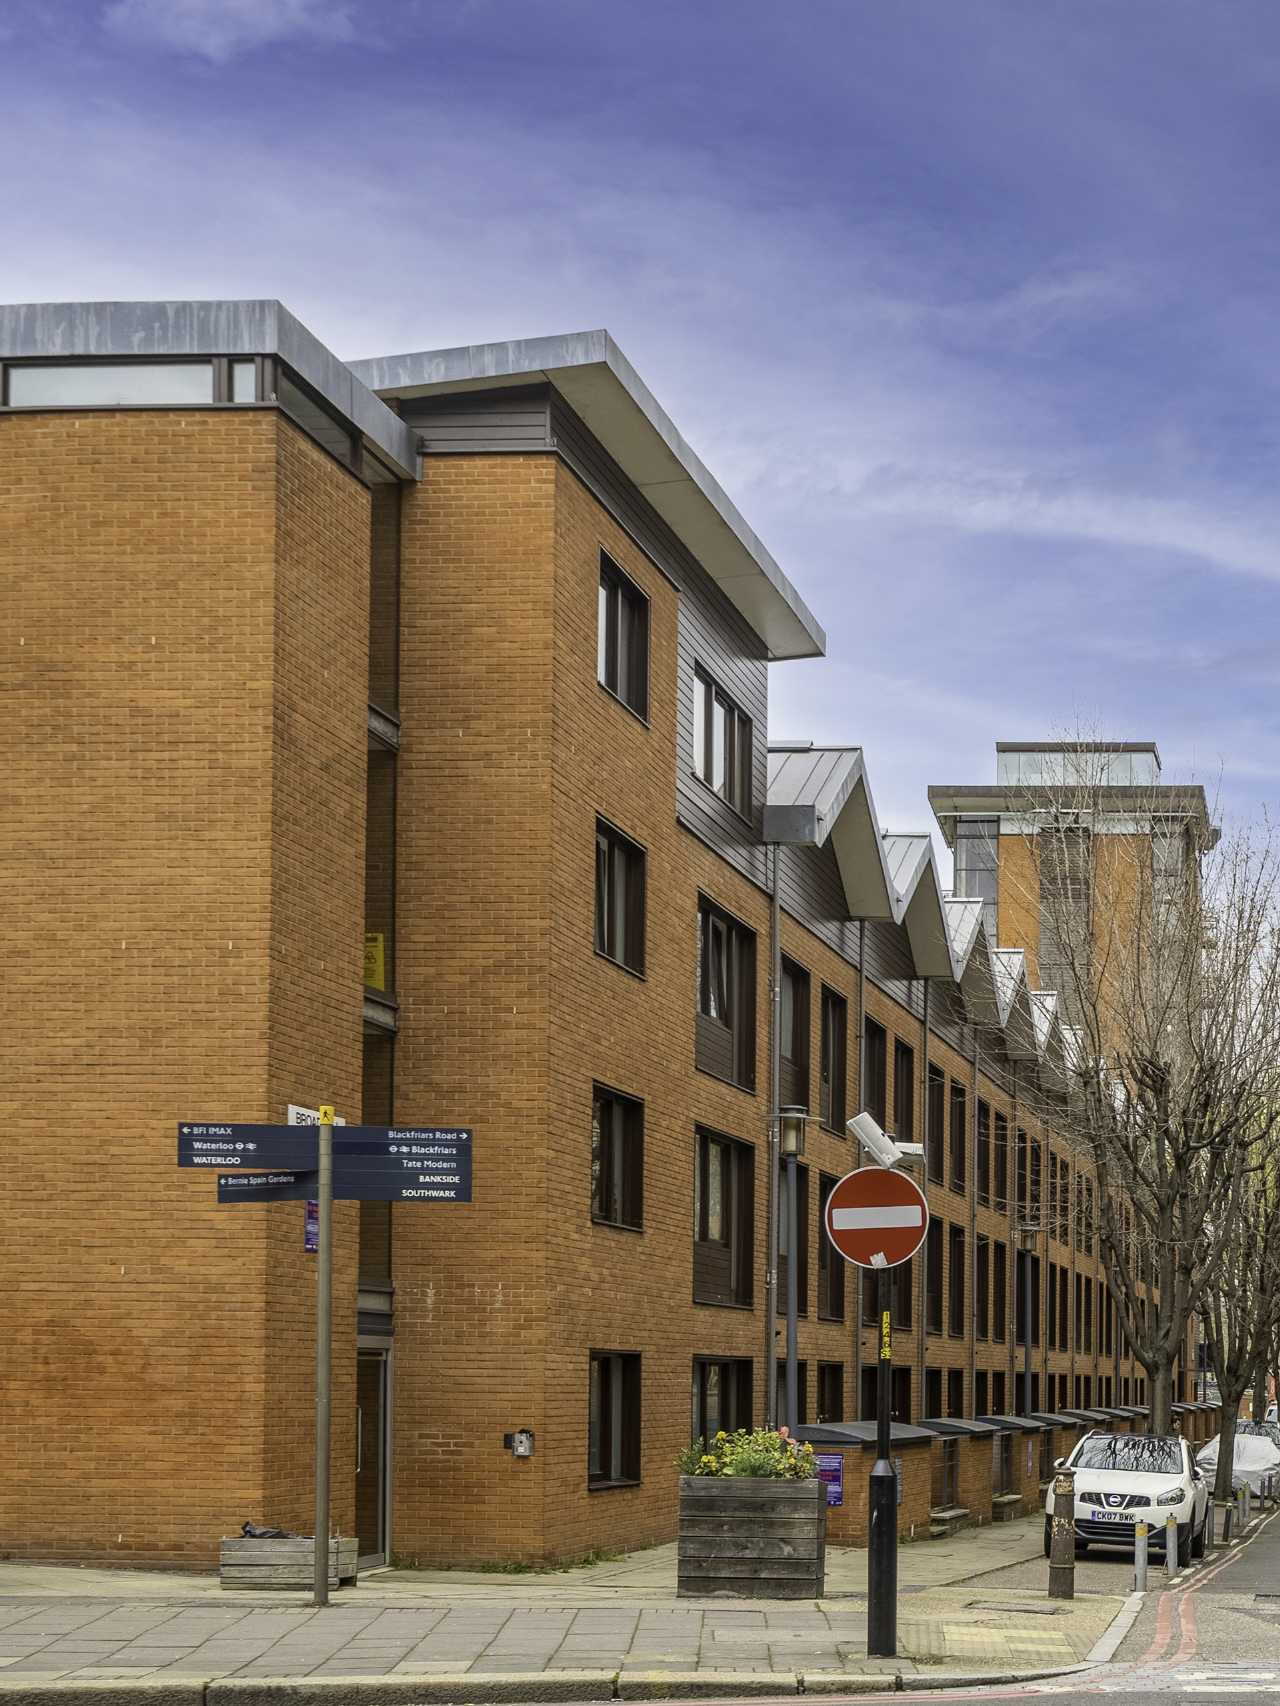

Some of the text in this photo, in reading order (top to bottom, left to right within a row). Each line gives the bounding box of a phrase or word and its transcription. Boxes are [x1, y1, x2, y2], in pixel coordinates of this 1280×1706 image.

[193, 1126, 232, 1135] BFI IMAX
[387, 1130, 457, 1140] Blackfriars Road
[192, 1141, 234, 1150] Waterloo
[411, 1145, 457, 1154] Blackfriars
[192, 1156, 241, 1164] WATERLOO
[402, 1160, 457, 1168] Tate Modern
[249, 1176, 267, 1186] Spain
[419, 1175, 461, 1183] BANKSIDE
[401, 1189, 457, 1198] SOUTHWARK
